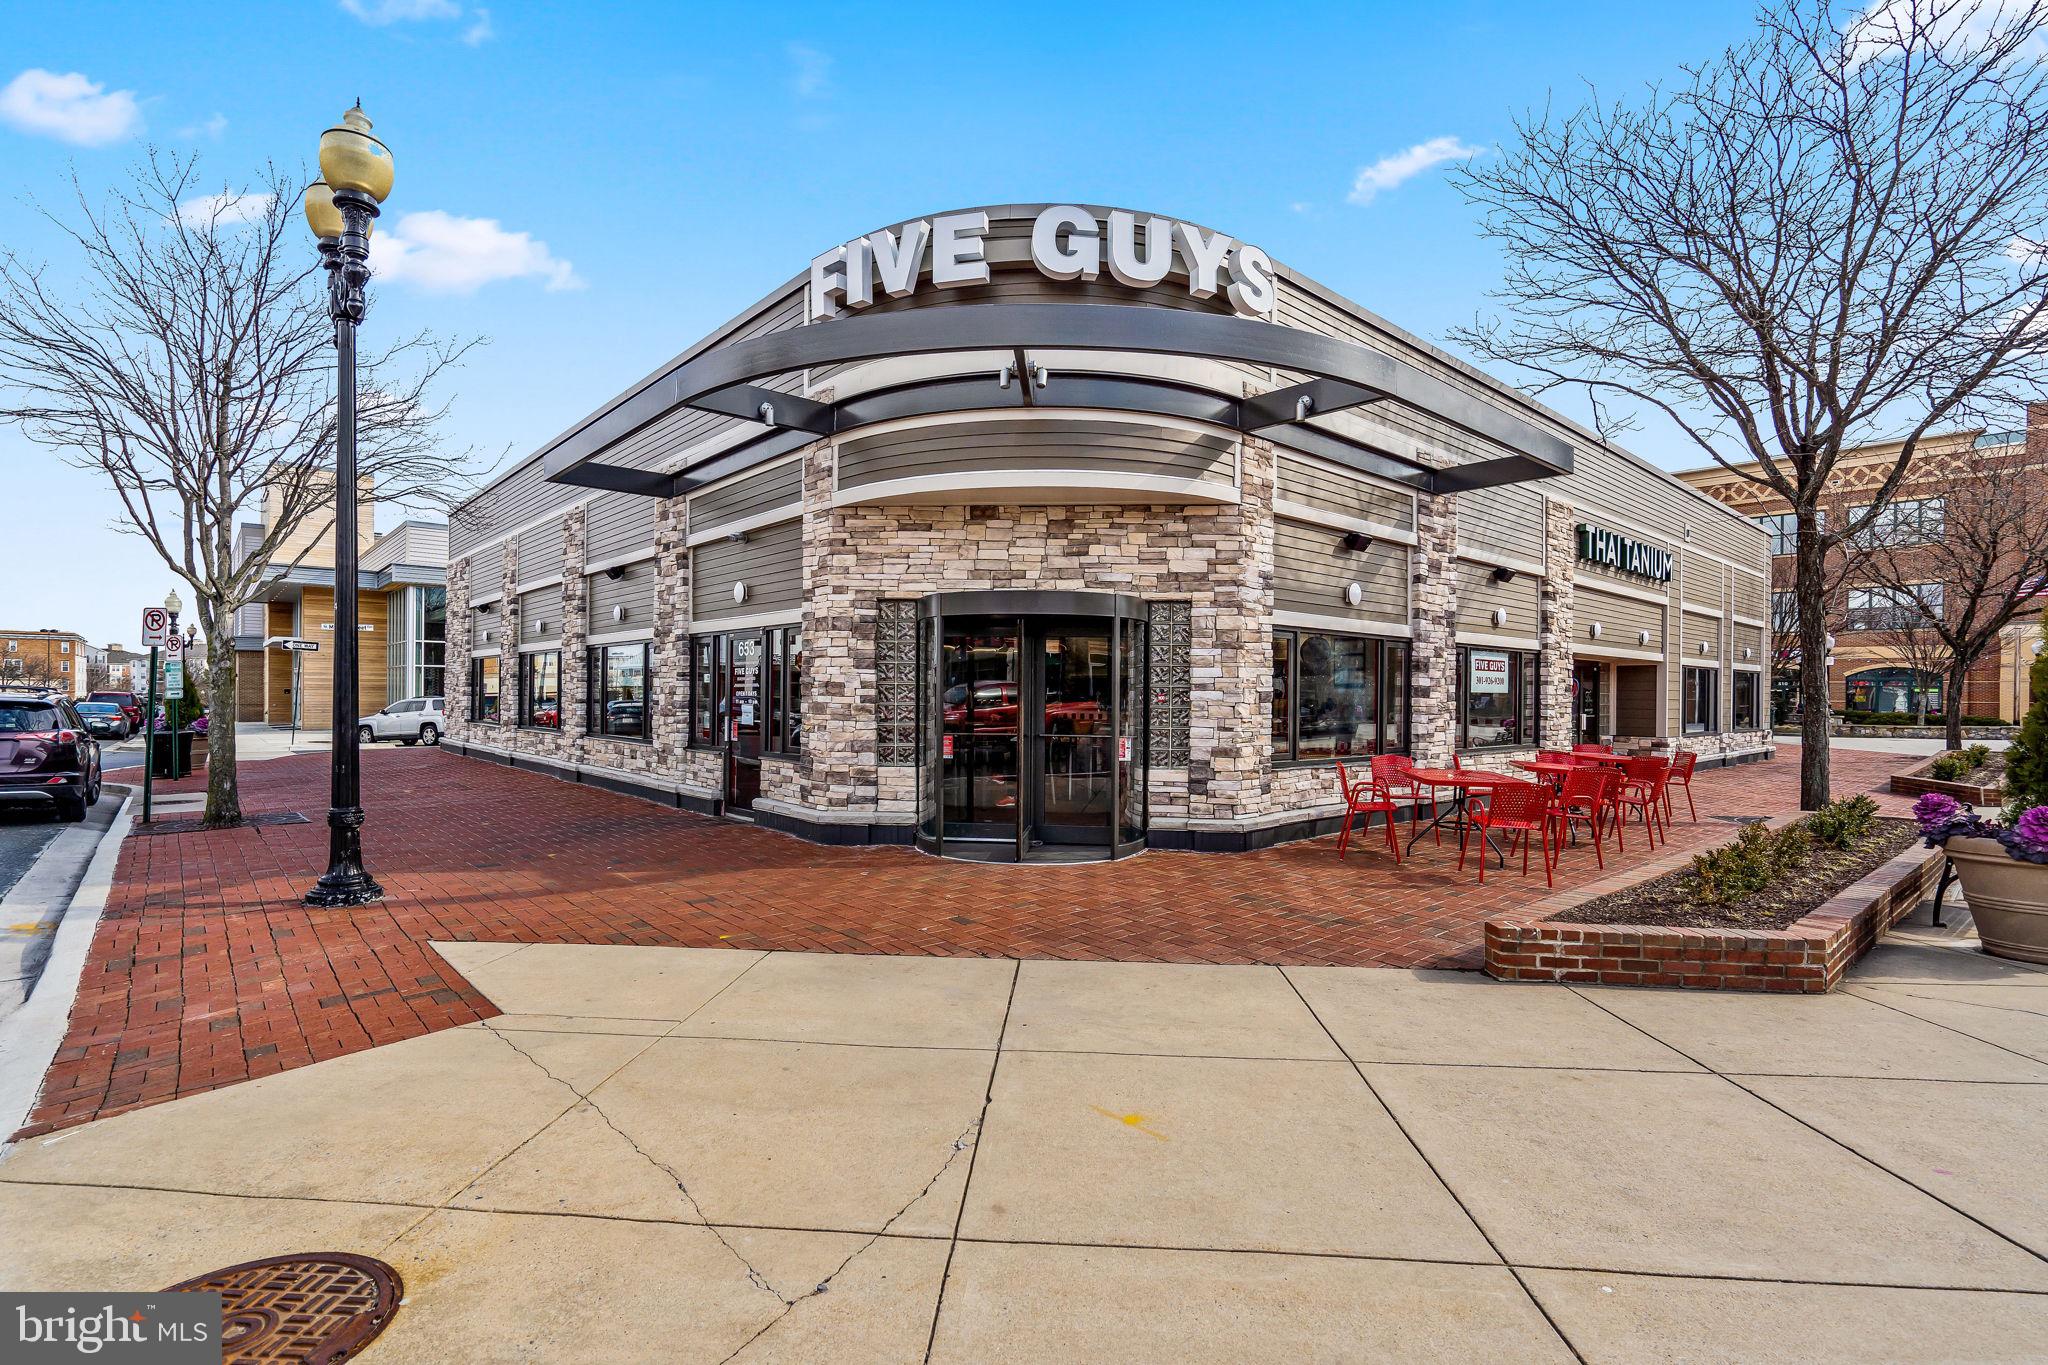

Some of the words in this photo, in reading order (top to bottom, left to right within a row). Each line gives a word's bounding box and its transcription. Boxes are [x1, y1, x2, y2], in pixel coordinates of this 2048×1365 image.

[811, 211, 990, 322] FIVE
[1031, 205, 1275, 316] GUYS
[738, 641, 754, 656] 653
[1475, 660, 1488, 670] FIVE
[1490, 662, 1504, 671] GUYS
